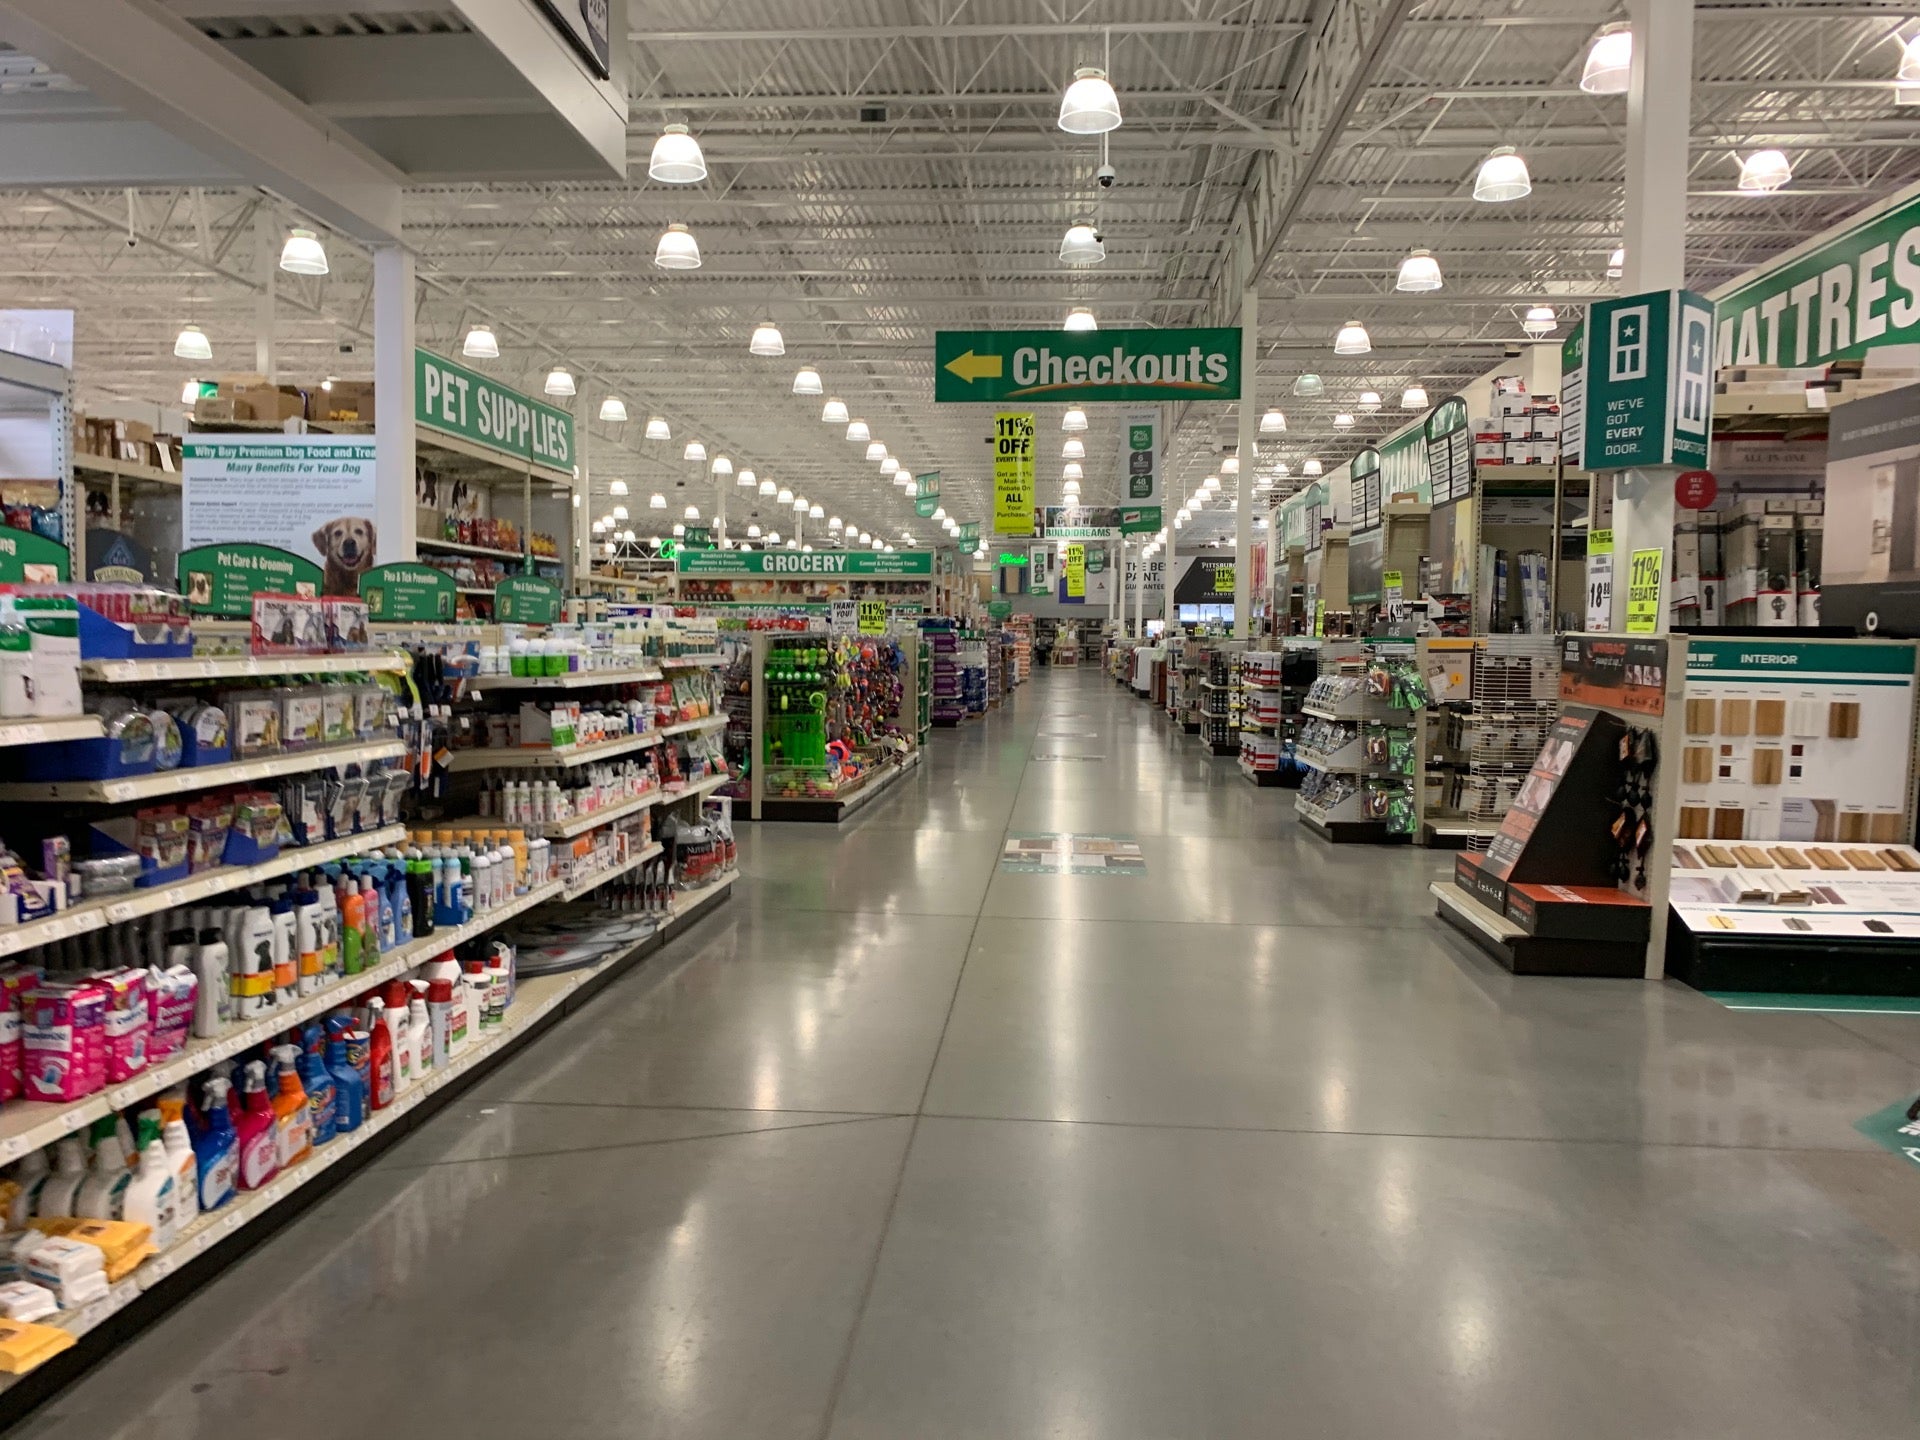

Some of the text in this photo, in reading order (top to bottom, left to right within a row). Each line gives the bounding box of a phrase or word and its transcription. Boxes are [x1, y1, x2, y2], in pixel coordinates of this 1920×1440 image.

[1012, 347, 1228, 386] Checkouts
[1607, 398, 1644, 411] WE'VE
[425, 363, 568, 462] PET SUPPLIES
[1607, 413, 1630, 425] GOT
[996, 417, 1033, 436] 11%
[1606, 426, 1644, 439] EVERY
[194, 446, 216, 458] Why
[218, 446, 236, 459] Buy
[239, 446, 283, 458] Premium
[285, 446, 304, 459] Dog
[307, 446, 331, 458] Food
[333, 446, 352, 458] and
[999, 438, 1030, 454] OFF
[1605, 443, 1640, 455] DOOR.
[226, 463, 361, 475] Many Benefits For Your Dog
[1006, 494, 1023, 502] ALL
[1073, 528, 1111, 537] DREAMS
[217, 551, 294, 575] Pet Care & Grooming
[762, 554, 847, 573] GROCERY
[401, 571, 412, 583] Tick
[413, 573, 438, 584] Prevention
[1126, 573, 1160, 581] PANT.
[1216, 569, 1234, 578] 11%
[1632, 556, 1660, 586] 11%
[1590, 582, 1602, 608] 18
[1629, 587, 1658, 601] REBATE
[836, 610, 853, 618] YOU!
[861, 602, 885, 615] 11%
[1740, 654, 1798, 665] INTERIOR
